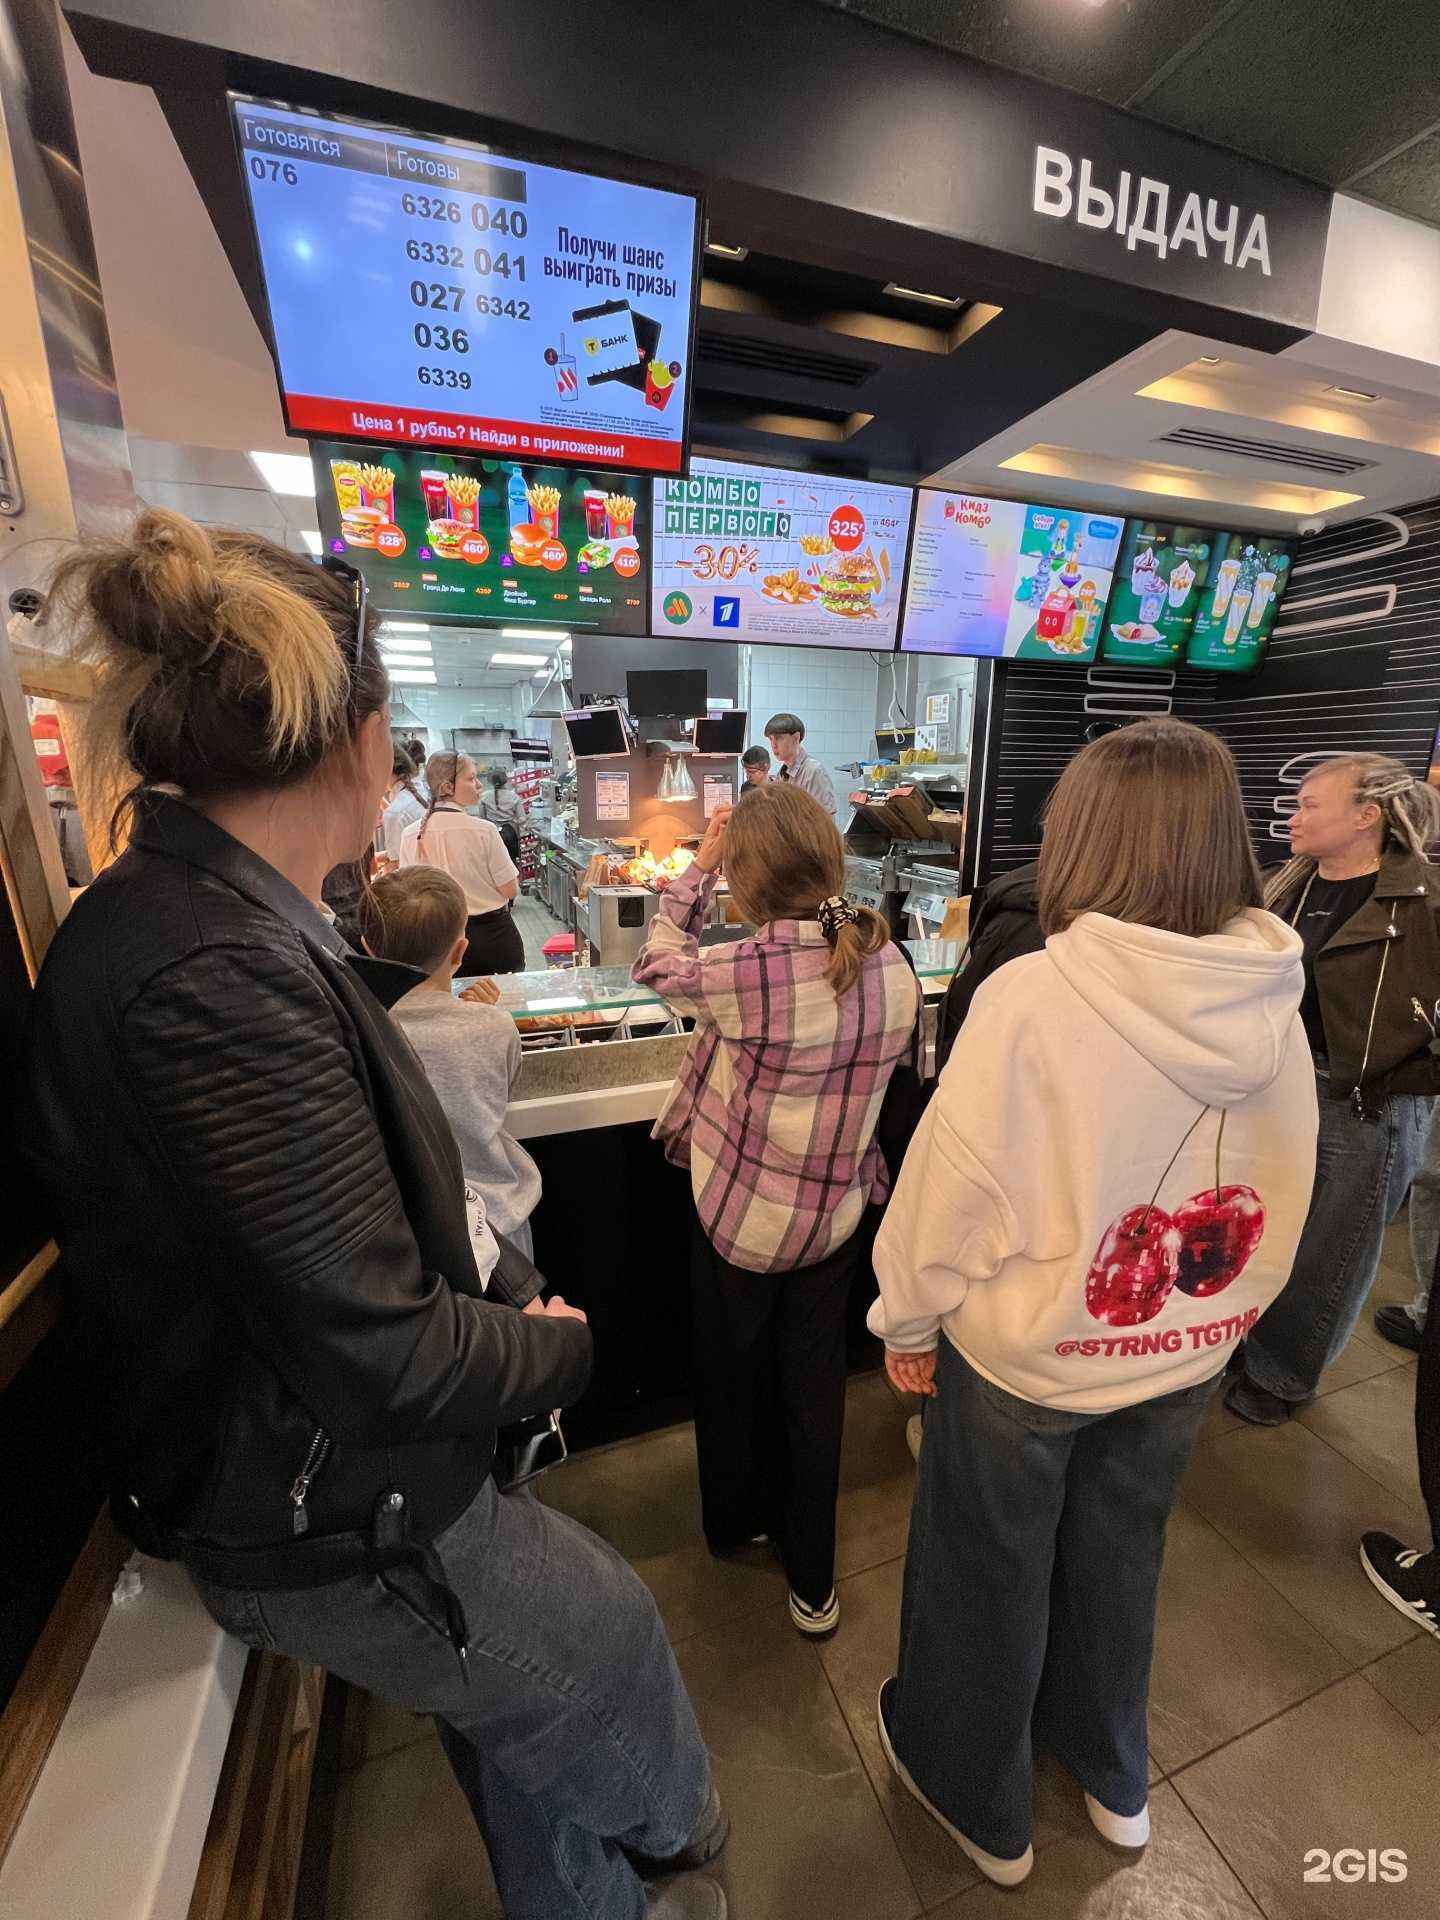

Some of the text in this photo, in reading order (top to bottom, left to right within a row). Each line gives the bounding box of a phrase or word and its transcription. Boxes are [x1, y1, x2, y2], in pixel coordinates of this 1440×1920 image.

[250, 156, 298, 186] 076
[402, 193, 528, 239] 6326 040
[1033, 145, 1272, 276] ВЫДАЧА
[406, 239, 525, 282] 6332 041
[558, 226, 665, 271] Получи шанс
[543, 256, 677, 299] выиграть призы
[410, 280, 530, 321] 027 6342
[414, 322, 469, 354] 036
[601, 334, 628, 349] БАНК
[417, 366, 471, 390] 6339
[352, 413, 624, 459] Цена 1 рубль? Найди в приложении!
[668, 480, 758, 502] КОМБО
[667, 511, 789, 534] ПЕРВОГО
[956, 512, 992, 528] Комбо
[675, 544, 761, 581] -30%
[1055, 1329, 1182, 1357] @STRNG
